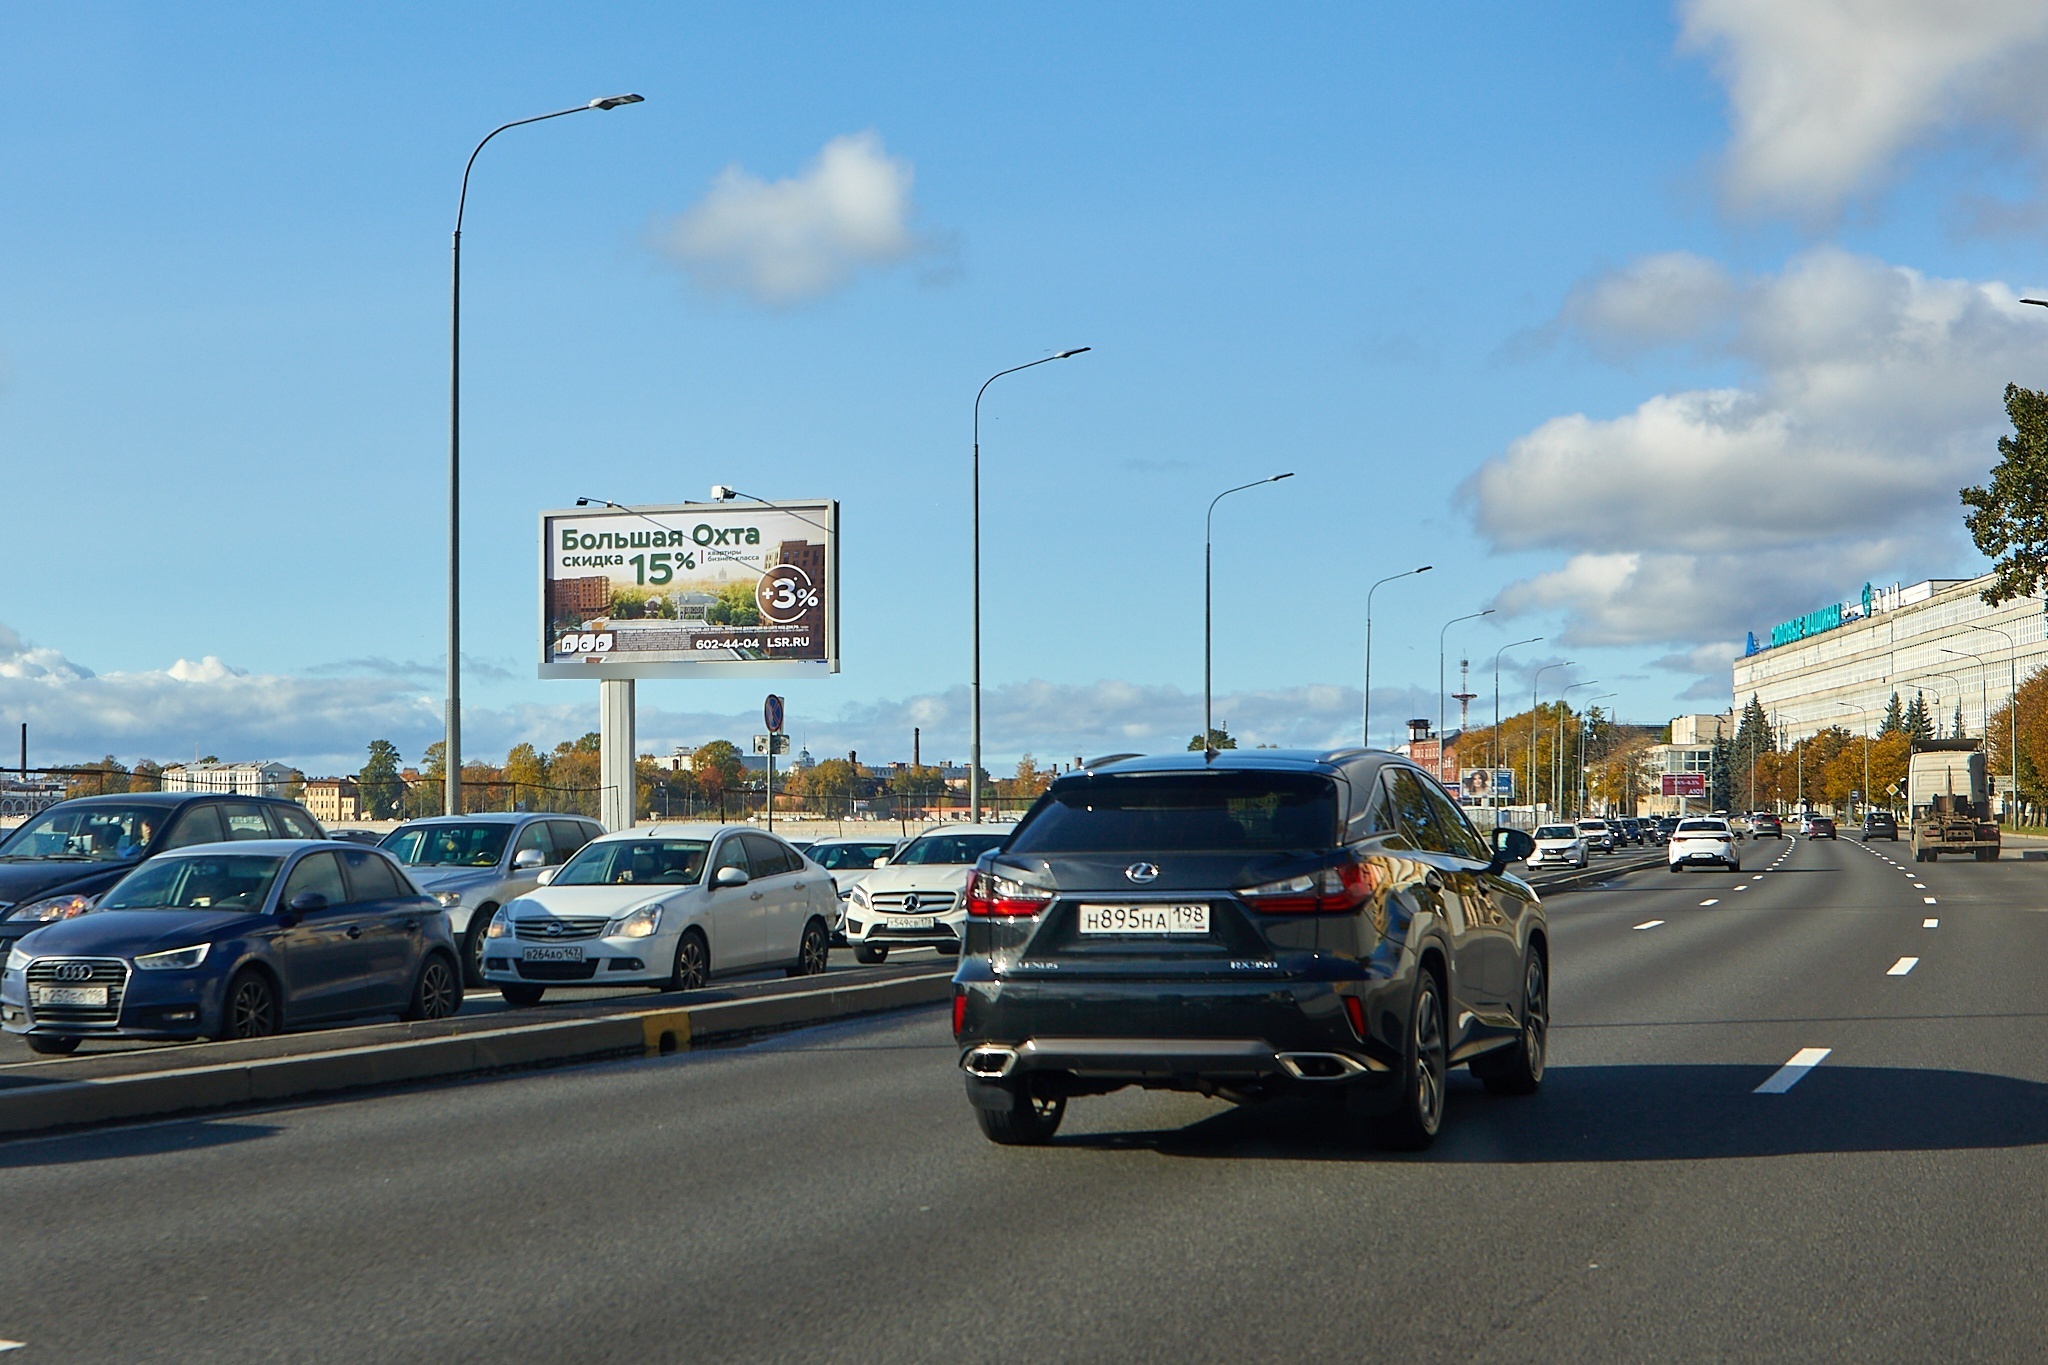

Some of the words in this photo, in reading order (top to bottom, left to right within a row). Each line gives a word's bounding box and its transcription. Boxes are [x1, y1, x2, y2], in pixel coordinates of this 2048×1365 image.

[562, 529, 683, 550] Большая
[693, 523, 760, 546] Охта
[707, 549, 742, 557] квартиры
[707, 554, 760, 562] бизнес-класса
[562, 554, 624, 568] скидка
[629, 552, 696, 586] 15%
[695, 638, 760, 650] 602-44-04
[767, 636, 810, 648] LSR.RU
[1172, 906, 1204, 923] 198
